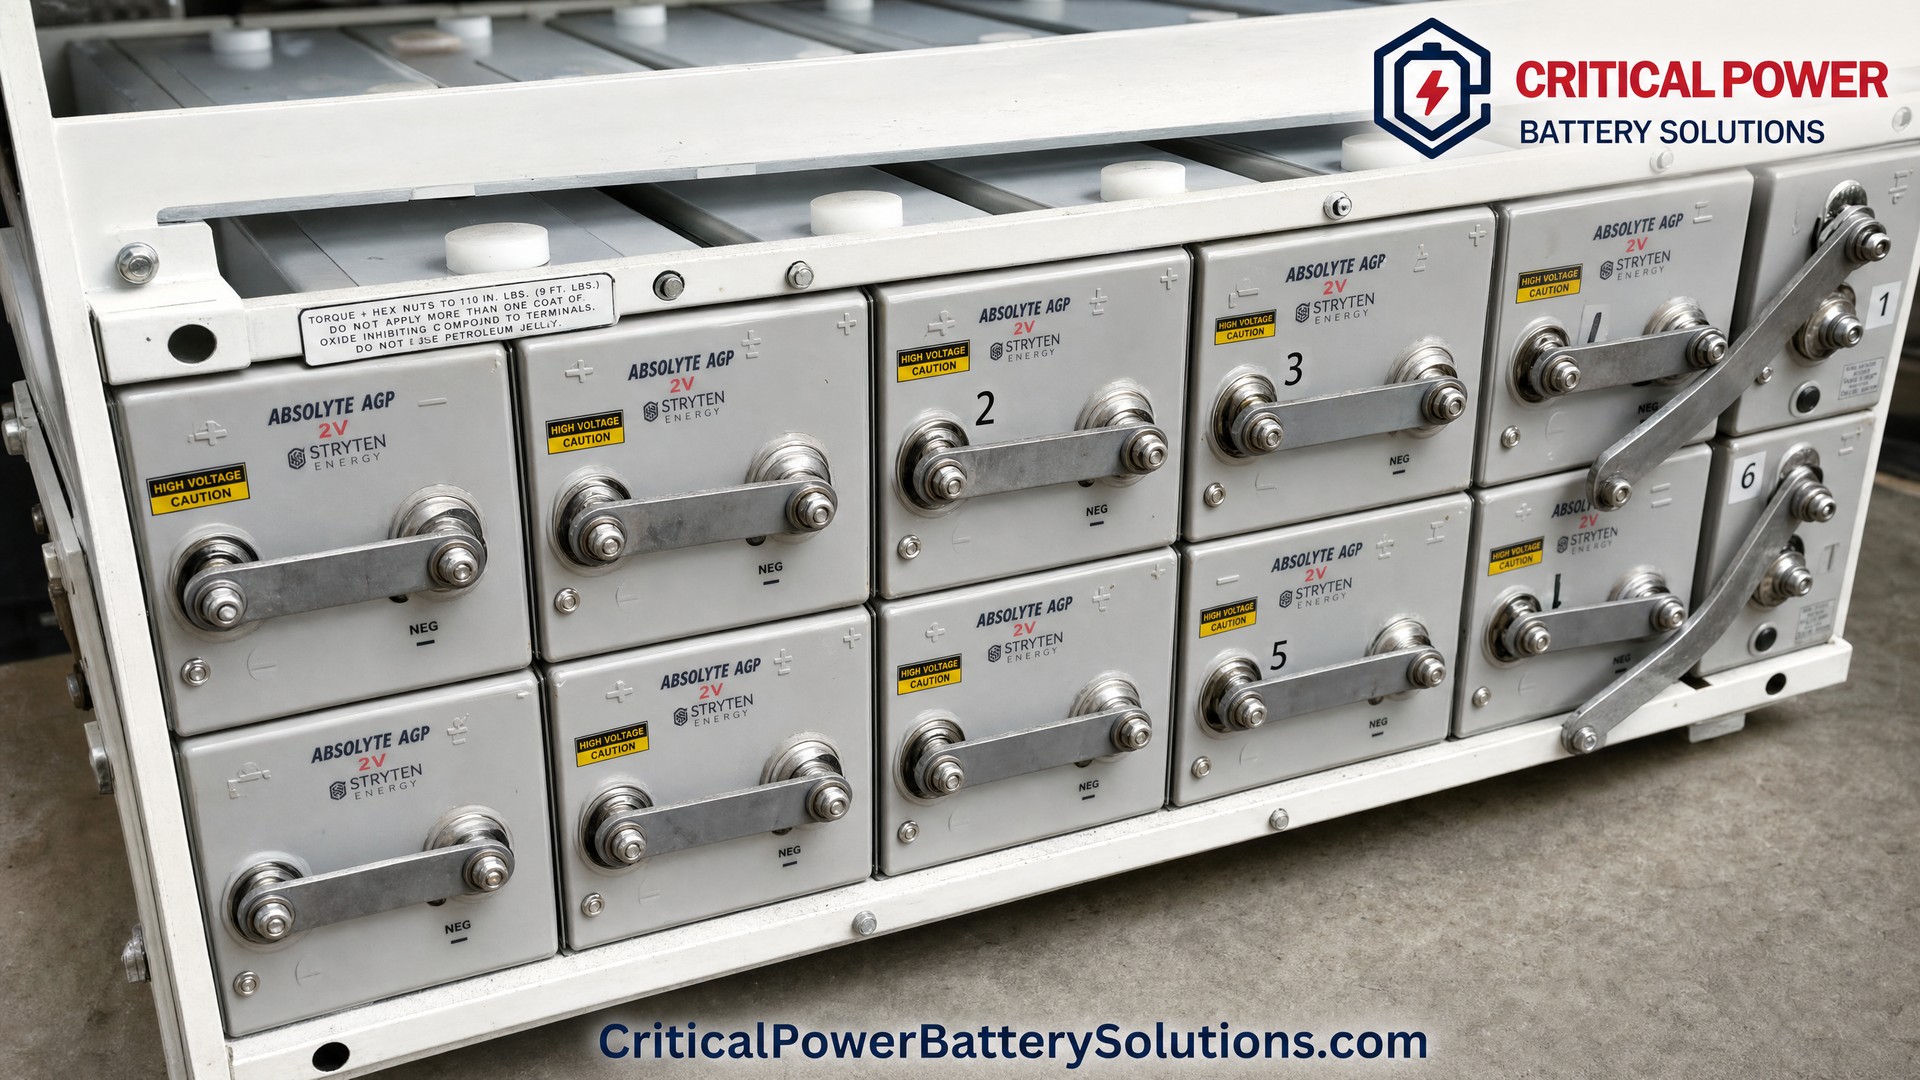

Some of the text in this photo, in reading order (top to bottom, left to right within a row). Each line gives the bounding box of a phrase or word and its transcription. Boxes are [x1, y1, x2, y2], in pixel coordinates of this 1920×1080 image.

[1593, 212, 1684, 241] ABSOLYTE AGP
[1625, 237, 1648, 252] 2V
[1285, 253, 1386, 283] ABSOLYTE AGP
[1616, 250, 1671, 270] STRYTEN
[1521, 269, 1579, 286] HIGH VOLTAGE
[1617, 266, 1665, 281] ENERGY
[1323, 279, 1348, 295] 2V
[1529, 283, 1570, 298] CAUTION
[308, 311, 356, 324] TORQUE
[372, 306, 397, 317] HEX
[403, 301, 435, 313] NUTS
[440, 299, 456, 308] TO
[460, 295, 478, 305] 110
[483, 293, 498, 303] IN.
[504, 290, 529, 300] LBS.
[549, 285, 566, 295] FT.
[571, 281, 600, 292] LBS.)
[979, 297, 1071, 324] ABSOLYTE AGP
[1313, 292, 1376, 314] STRYTEN
[1879, 292, 1890, 317] 1
[329, 324, 347, 334] DO
[353, 320, 379, 331] NOT
[385, 314, 421, 327] APPLY
[427, 309, 460, 321] MORE
[466, 305, 498, 316] THAN
[503, 301, 528, 311] ONE
[533, 296, 563, 308] COAT
[1218, 314, 1273, 330] HIGH VOLTAGE
[1315, 309, 1369, 325] ENERGY
[320, 334, 357, 347] OXIDE
[363, 325, 427, 341] INHIBITING
[505, 313, 521, 322] TO
[526, 303, 595, 320] TERMINALS.
[1013, 320, 1035, 335] 2V
[1226, 327, 1265, 341] CAUTION
[355, 344, 373, 353] DO
[379, 339, 404, 350] NOT
[445, 325, 513, 341] PETROLEUM
[1005, 333, 1060, 353] STRYTEN
[901, 346, 966, 363] HIGH VOLTAGE
[1008, 349, 1055, 362] ENERGY
[628, 350, 735, 381] ABSOLYTE AGP
[912, 361, 957, 376] CAUTION
[1284, 352, 1303, 386] 3
[670, 376, 695, 394] 2V
[267, 390, 396, 426] ABSOLYTE AGP
[661, 391, 725, 413] STRYTEN
[975, 390, 995, 426] 2
[1638, 402, 1659, 414] NEG
[665, 407, 721, 424] ENERGY
[318, 420, 349, 439] 2V
[551, 416, 620, 435] HIGH VOLTAGE
[310, 434, 387, 460] STRYTEN
[562, 432, 611, 448] CAUTION
[315, 452, 381, 471] ENERGY
[1389, 454, 1410, 466] NEG
[153, 470, 242, 494] HIGH VOLTAGE
[1741, 462, 1756, 489] 6
[170, 487, 232, 507] CAUTION
[1086, 504, 1108, 516] NEG
[1551, 499, 1597, 518] ABSOL
[1578, 513, 1599, 529] 2V
[1570, 526, 1618, 546] STRYTEN
[1492, 541, 1541, 560] HIGH VOLTAGE
[1571, 540, 1613, 555] ENERGY
[1271, 542, 1363, 573] ABSOLYTE AGP
[1499, 554, 1533, 570] CAUTION
[758, 562, 784, 575] NEG
[1304, 566, 1328, 582] 2V
[1295, 577, 1353, 600] STRYTEN
[1297, 593, 1346, 609] ENERGY
[976, 596, 1073, 628] ABSOLYTE AGP
[1203, 602, 1254, 622] HIGH VOLTAGE
[409, 620, 439, 636] NEG
[1013, 621, 1037, 637] 2V
[1210, 616, 1246, 632] CAUTION
[1004, 632, 1063, 654] STRYTEN
[1007, 647, 1058, 663] ENERGY
[1270, 640, 1288, 671] 5
[1613, 653, 1631, 666] NEG
[660, 657, 761, 690] ABSOLYTE AGP
[901, 659, 958, 678] HIGH VOLTAGE
[910, 673, 950, 689] CAUTION
[698, 683, 724, 700] 2V
[691, 694, 754, 717] STRYTEN
[694, 709, 749, 727] ENERGY
[1369, 717, 1388, 729] NEG
[311, 725, 430, 764] ABSOLYTE AGP
[579, 727, 644, 750] HIGH VOLTAGE
[590, 742, 636, 760] CAUTION
[358, 754, 387, 771] 2V
[350, 763, 423, 790] STRYTEN
[1078, 779, 1100, 792] NEG
[354, 779, 417, 801] ENERGY
[778, 845, 801, 858] NEG
[444, 919, 472, 934] NEG
